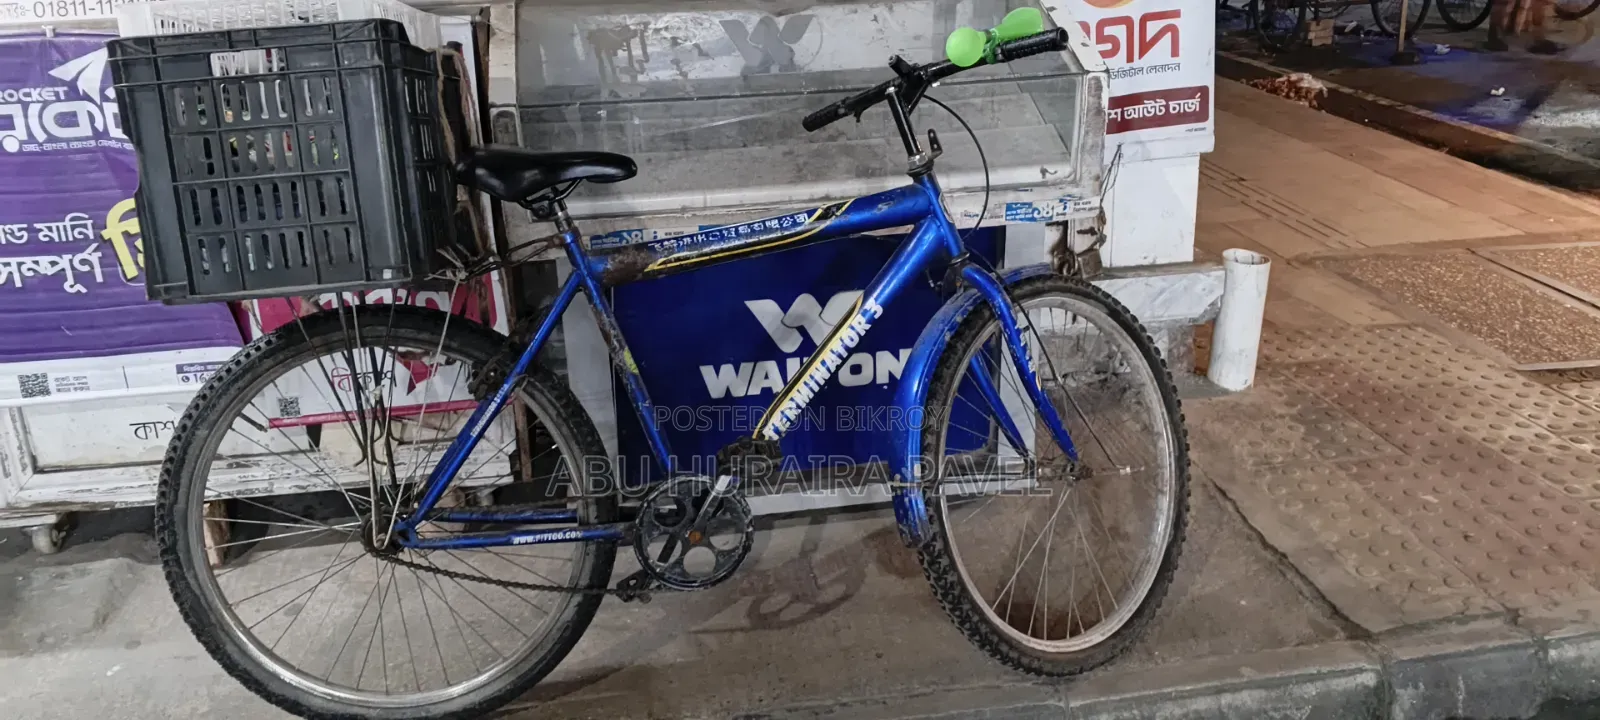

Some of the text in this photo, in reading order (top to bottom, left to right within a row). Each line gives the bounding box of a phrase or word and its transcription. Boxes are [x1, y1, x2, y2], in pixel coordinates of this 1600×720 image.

[1076, 9, 1181, 64] গদ
[1146, 62, 1181, 75] লেনদেন
[1123, 99, 1167, 120] আউট
[1168, 92, 1202, 115] চার্জ
[33, 212, 94, 243] মানি
[0, 242, 104, 293] সম্পূর্ণ
[699, 347, 912, 399] WAON
[763, 297, 884, 441] TERMINATOR 3
